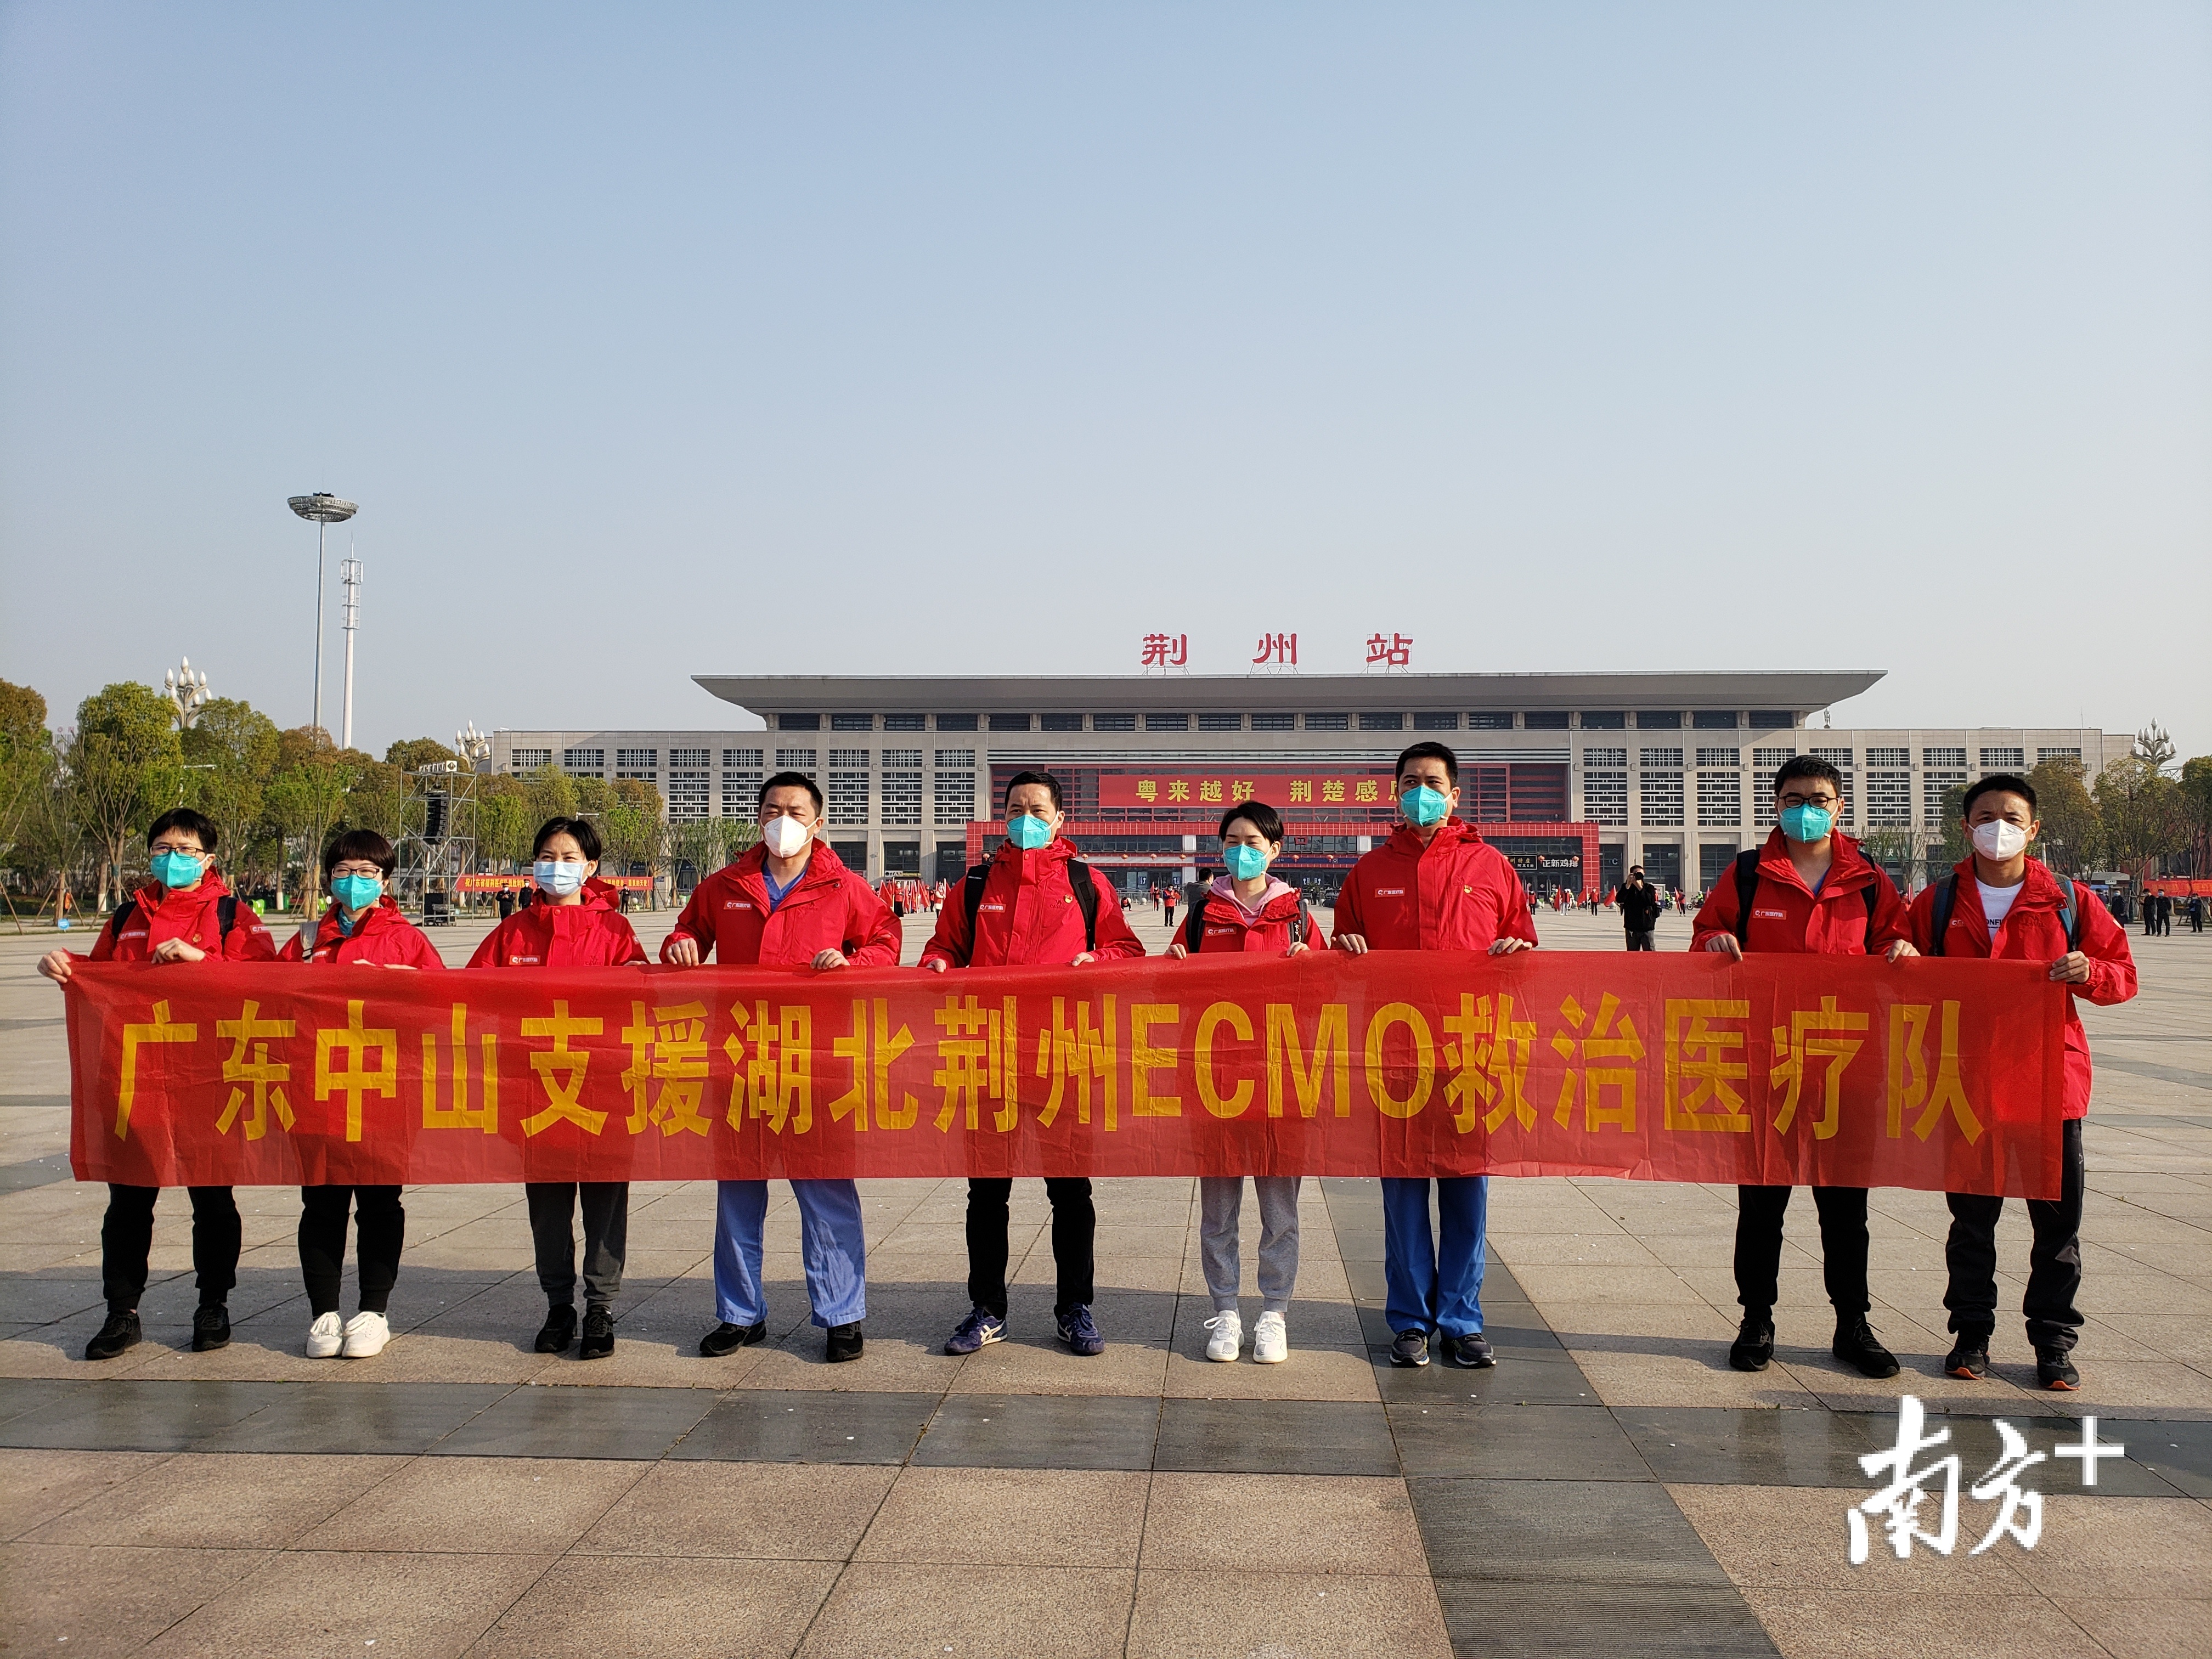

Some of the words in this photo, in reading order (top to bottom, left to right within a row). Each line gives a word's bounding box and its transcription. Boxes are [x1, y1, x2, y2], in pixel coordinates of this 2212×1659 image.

[1141, 633, 1413, 666] 荆州站
[1136, 779, 1255, 802] 粤来越好
[1542, 859, 1578, 867] 正新鸡排
[115, 994, 1984, 1146] 广东中山支援湖北荆州ECMO救治医疗队
